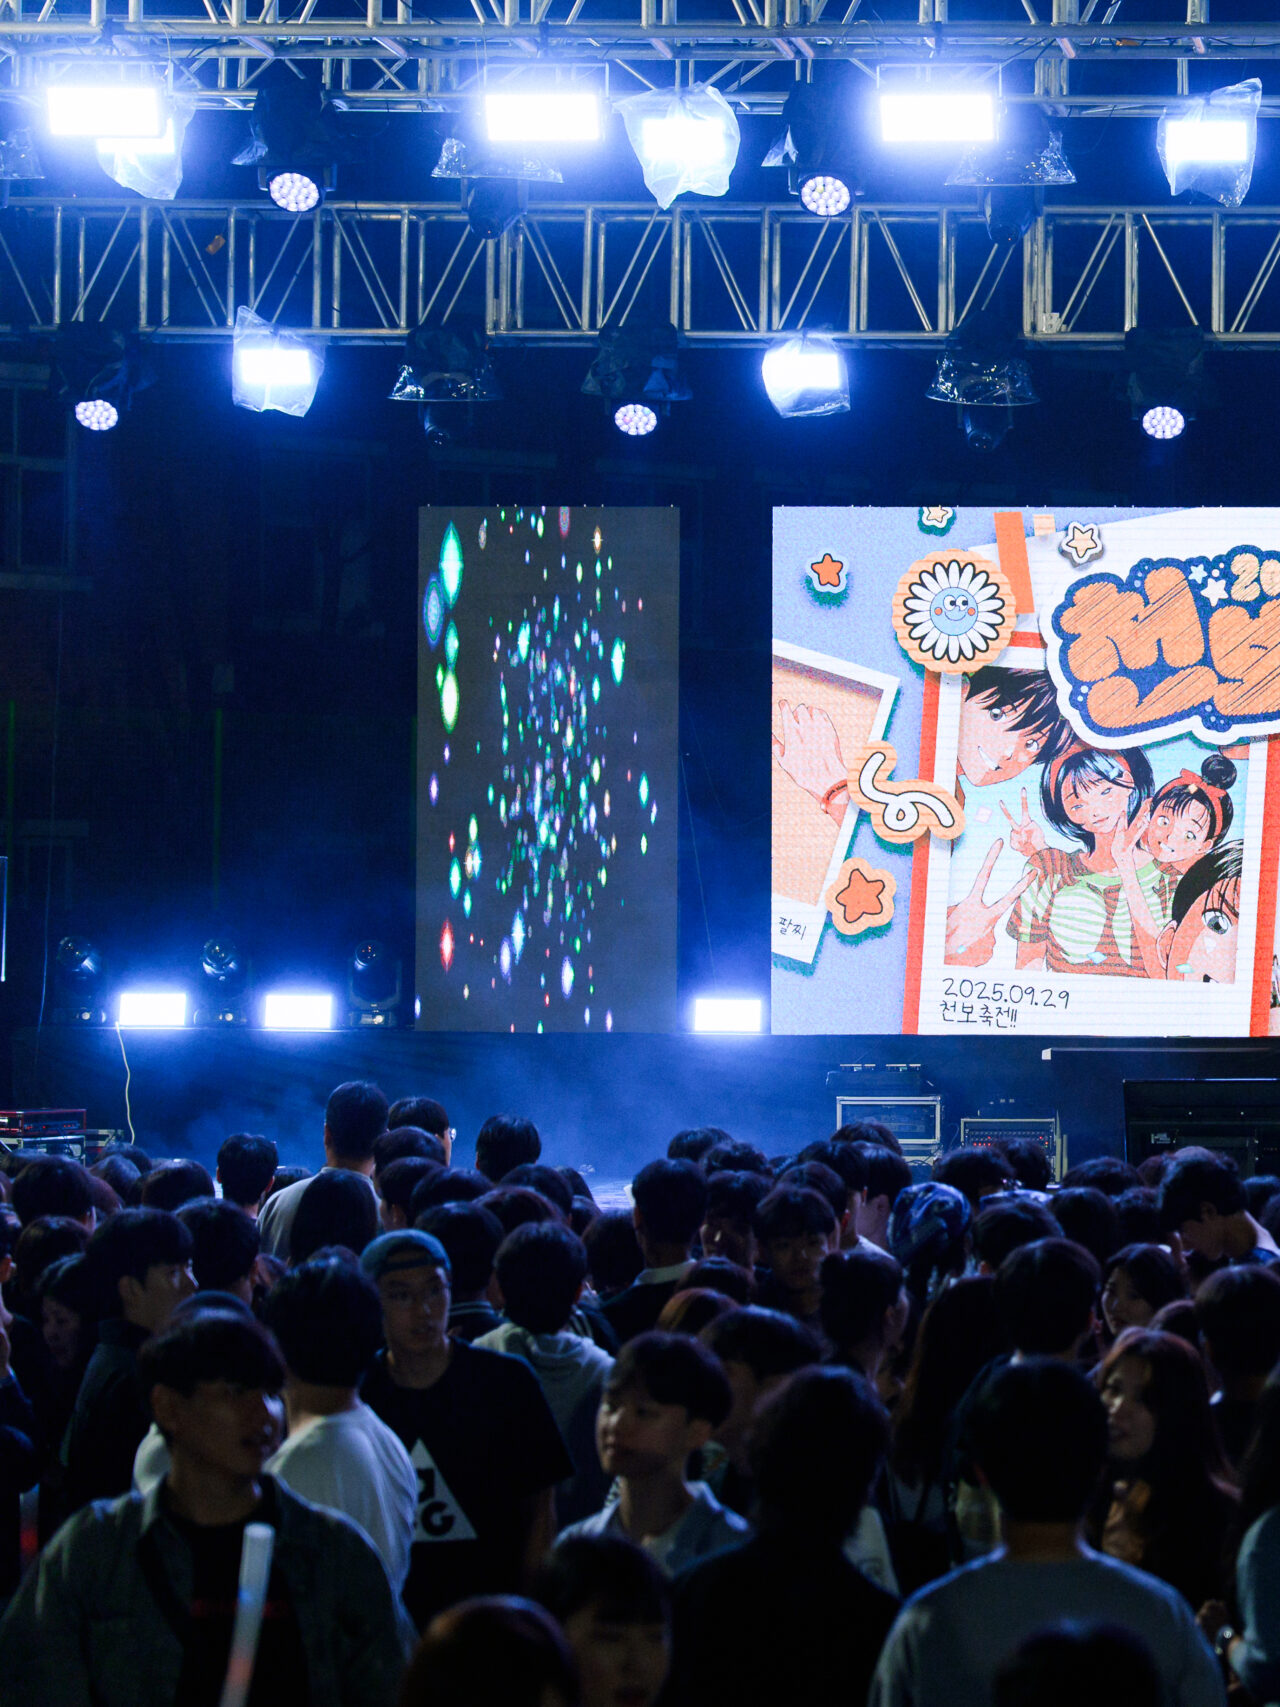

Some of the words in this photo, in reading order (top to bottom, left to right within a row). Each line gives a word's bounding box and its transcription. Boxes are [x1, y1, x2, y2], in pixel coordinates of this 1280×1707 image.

[779, 916, 807, 941] 팔찌
[942, 977, 1070, 1010] 2025.09.29
[940, 1000, 1018, 1029] 천보축전!!
